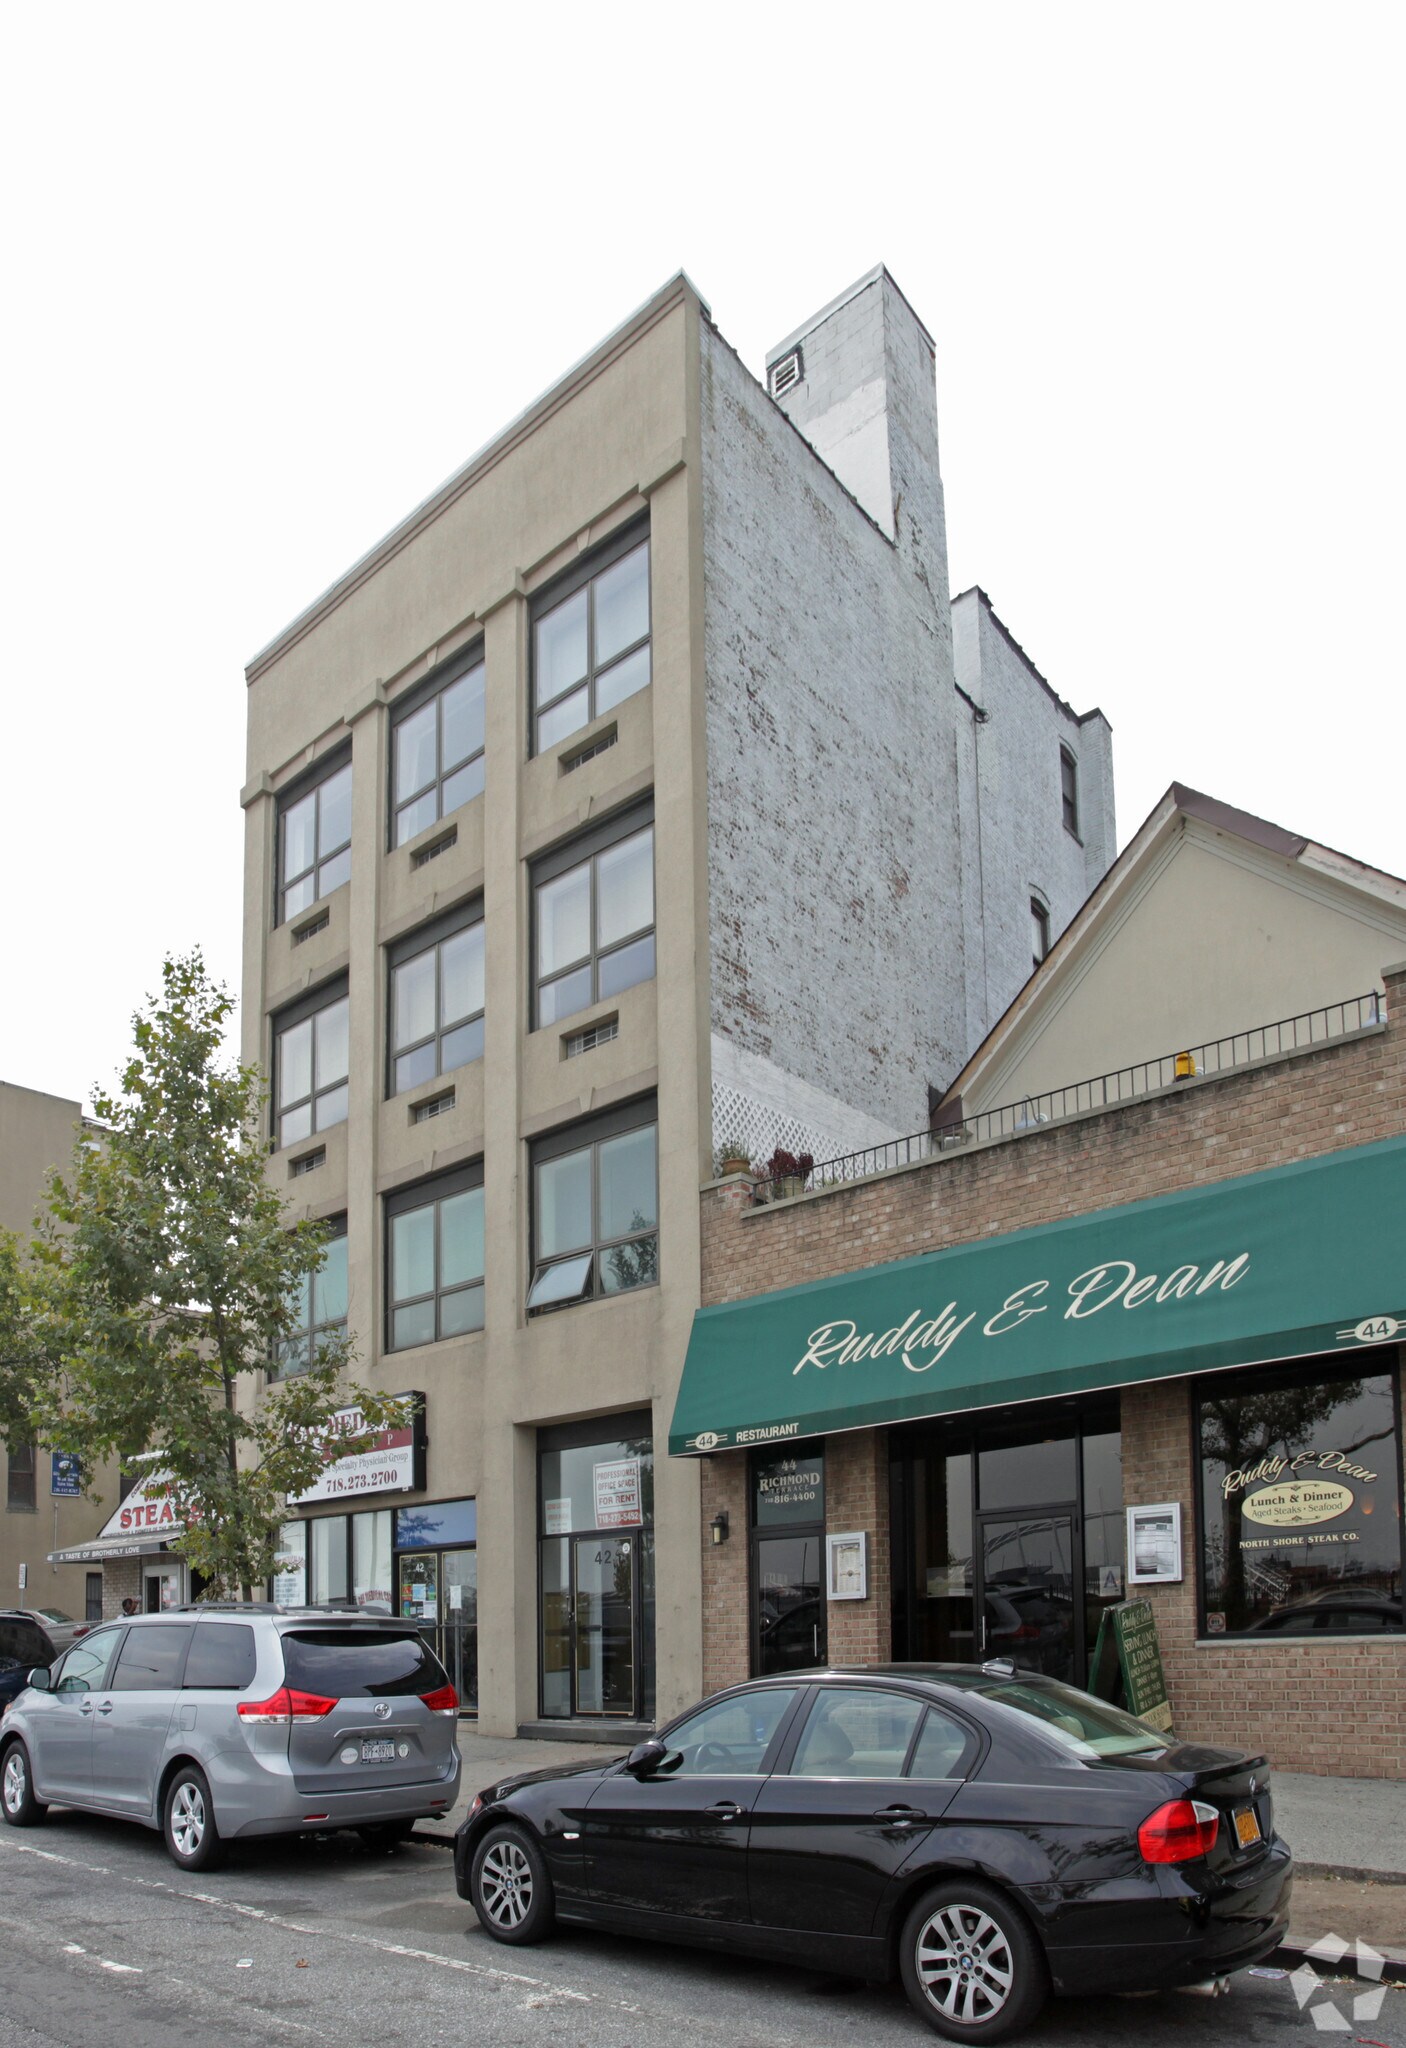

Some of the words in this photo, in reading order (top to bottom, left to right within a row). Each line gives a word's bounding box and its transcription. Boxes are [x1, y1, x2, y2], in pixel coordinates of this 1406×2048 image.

[792, 1302, 976, 1374] Ruddy
[982, 1280, 1050, 1336] &
[1063, 1252, 1251, 1321] Dean
[1362, 1320, 1390, 1338] 44
[699, 1435, 714, 1447] 44
[736, 1422, 799, 1443] RESTAURANT
[359, 1454, 388, 1469] Physician
[388, 1451, 409, 1464] Group
[781, 1458, 798, 1471] 44
[326, 1469, 398, 1493] 718.273.2700
[597, 1467, 637, 1481] PROFESSIONAL
[759, 1472, 821, 1492] RICHMOND
[1221, 1455, 1289, 1500] Ruddy
[1290, 1450, 1316, 1470] &
[1318, 1450, 1379, 1484] Dean
[598, 1480, 617, 1491] OFFICE
[598, 1496, 614, 1506] FOR
[615, 1493, 637, 1504] RENT
[774, 1491, 816, 1504] 816-4400
[1250, 1495, 1286, 1507] Lunch
[1289, 1494, 1300, 1503] &
[1303, 1491, 1344, 1502] Dinner
[1251, 1507, 1272, 1519] Aged
[1273, 1504, 1302, 1516] Steaks
[1308, 1501, 1343, 1512] Seafood
[1239, 1540, 1270, 1549] NORTH
[1273, 1536, 1304, 1546] SHORE
[1307, 1534, 1339, 1544] STEAK
[1342, 1532, 1360, 1541] CO.
[65, 1552, 81, 1560] TASTE
[91, 1547, 124, 1558] BROTHERLY
[125, 1546, 140, 1554] LOVE
[415, 1562, 425, 1573] 42
[1103, 1570, 1118, 1588] A
